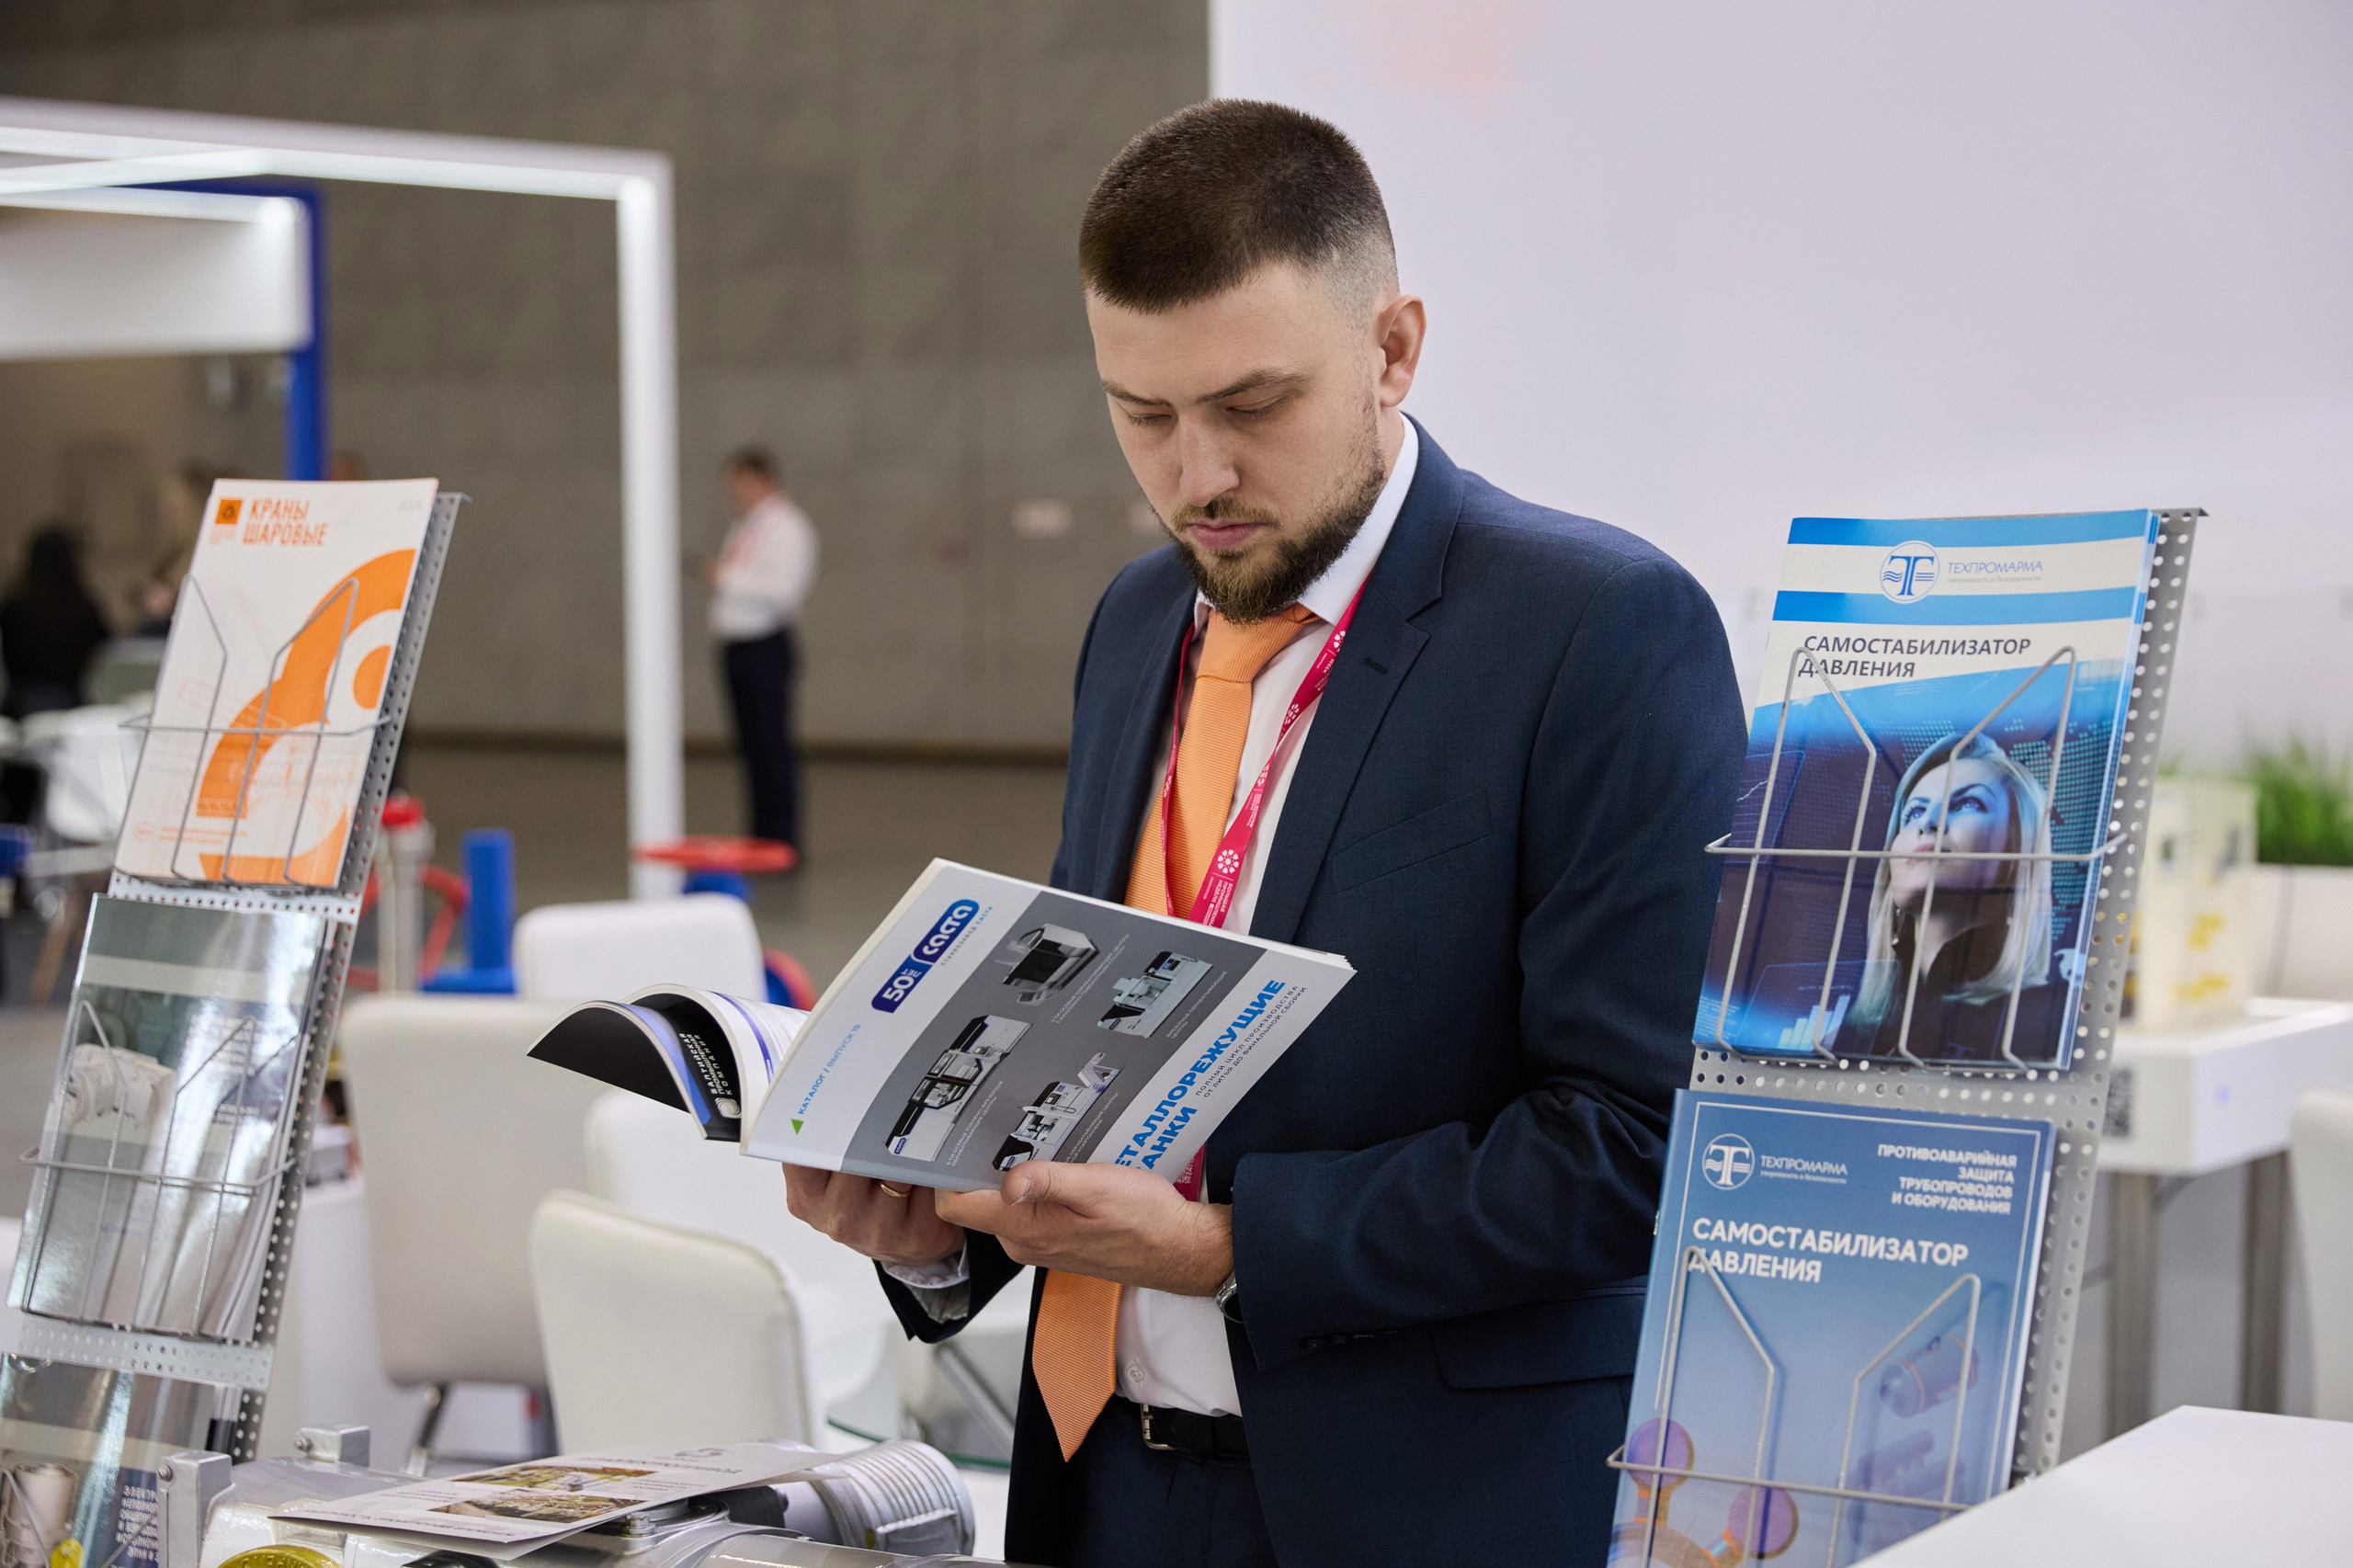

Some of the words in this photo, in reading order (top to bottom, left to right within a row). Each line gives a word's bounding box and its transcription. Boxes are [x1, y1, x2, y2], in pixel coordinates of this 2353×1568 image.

[248, 497, 311, 521] КРАНЫ
[242, 521, 330, 547] ШАРОВЫЕ
[1948, 561, 2043, 574] ТЕХПРОМАРМА
[1803, 635, 2031, 655] САМОСТАБИЛИЗАТОР
[1798, 658, 1915, 678] ДАВЛЕНИЯ
[1209, 881, 1228, 926] ПРОМЫШЛЕНН
[1211, 880, 1222, 903] НЕДЕЛЯ
[1221, 883, 1233, 913] БОЛЬШАЯ
[940, 925, 977, 967] СТАНКОЗАВОД
[975, 904, 994, 926] САСТА
[883, 973, 914, 1002] 50
[1195, 1063, 1225, 1097] ПОЛНЫЙ
[1225, 1043, 1245, 1065] ЦИКЛ
[1245, 983, 1299, 1043] ПРОИЗВОДСТВА
[1212, 1065, 1233, 1089] ЛИТЬЯ
[1242, 1013, 1282, 1057] ФИНАЛЬНОЙ
[1279, 986, 1307, 1016] СБОРКИ
[679, 1034, 718, 1094] БАЛТИЙСКАЯ
[687, 1035, 725, 1094] ПРОМЫШЛЕННАЯ
[694, 1035, 733, 1094] КОМПАНИЯ
[797, 1073, 826, 1116] КАТАЛОГ
[826, 1032, 854, 1068] ВЫПУСК
[850, 1022, 861, 1033] 19
[1114, 981, 1285, 1165] ЕТАЛЛОРЕЖУЩИЕ
[1142, 1107, 1198, 1170] АНКИ
[1761, 1155, 1847, 1176] ТЕХПРОМАРМА
[1878, 1143, 2018, 1168] ПРОТИВОАВАРИЙНАЯ
[1899, 1176, 2013, 1199] ТРУБОПРОВОДОВ
[1958, 1166, 2015, 1184] ЗАЩИТА
[1892, 1192, 1903, 1205] И
[1904, 1193, 2011, 1214] ОБОРУДОВАНИЯ
[1693, 1218, 1969, 1267] САМОСТАБИЛИЗАТОР
[1688, 1248, 1822, 1283] ДАВЛЕНИЯ
